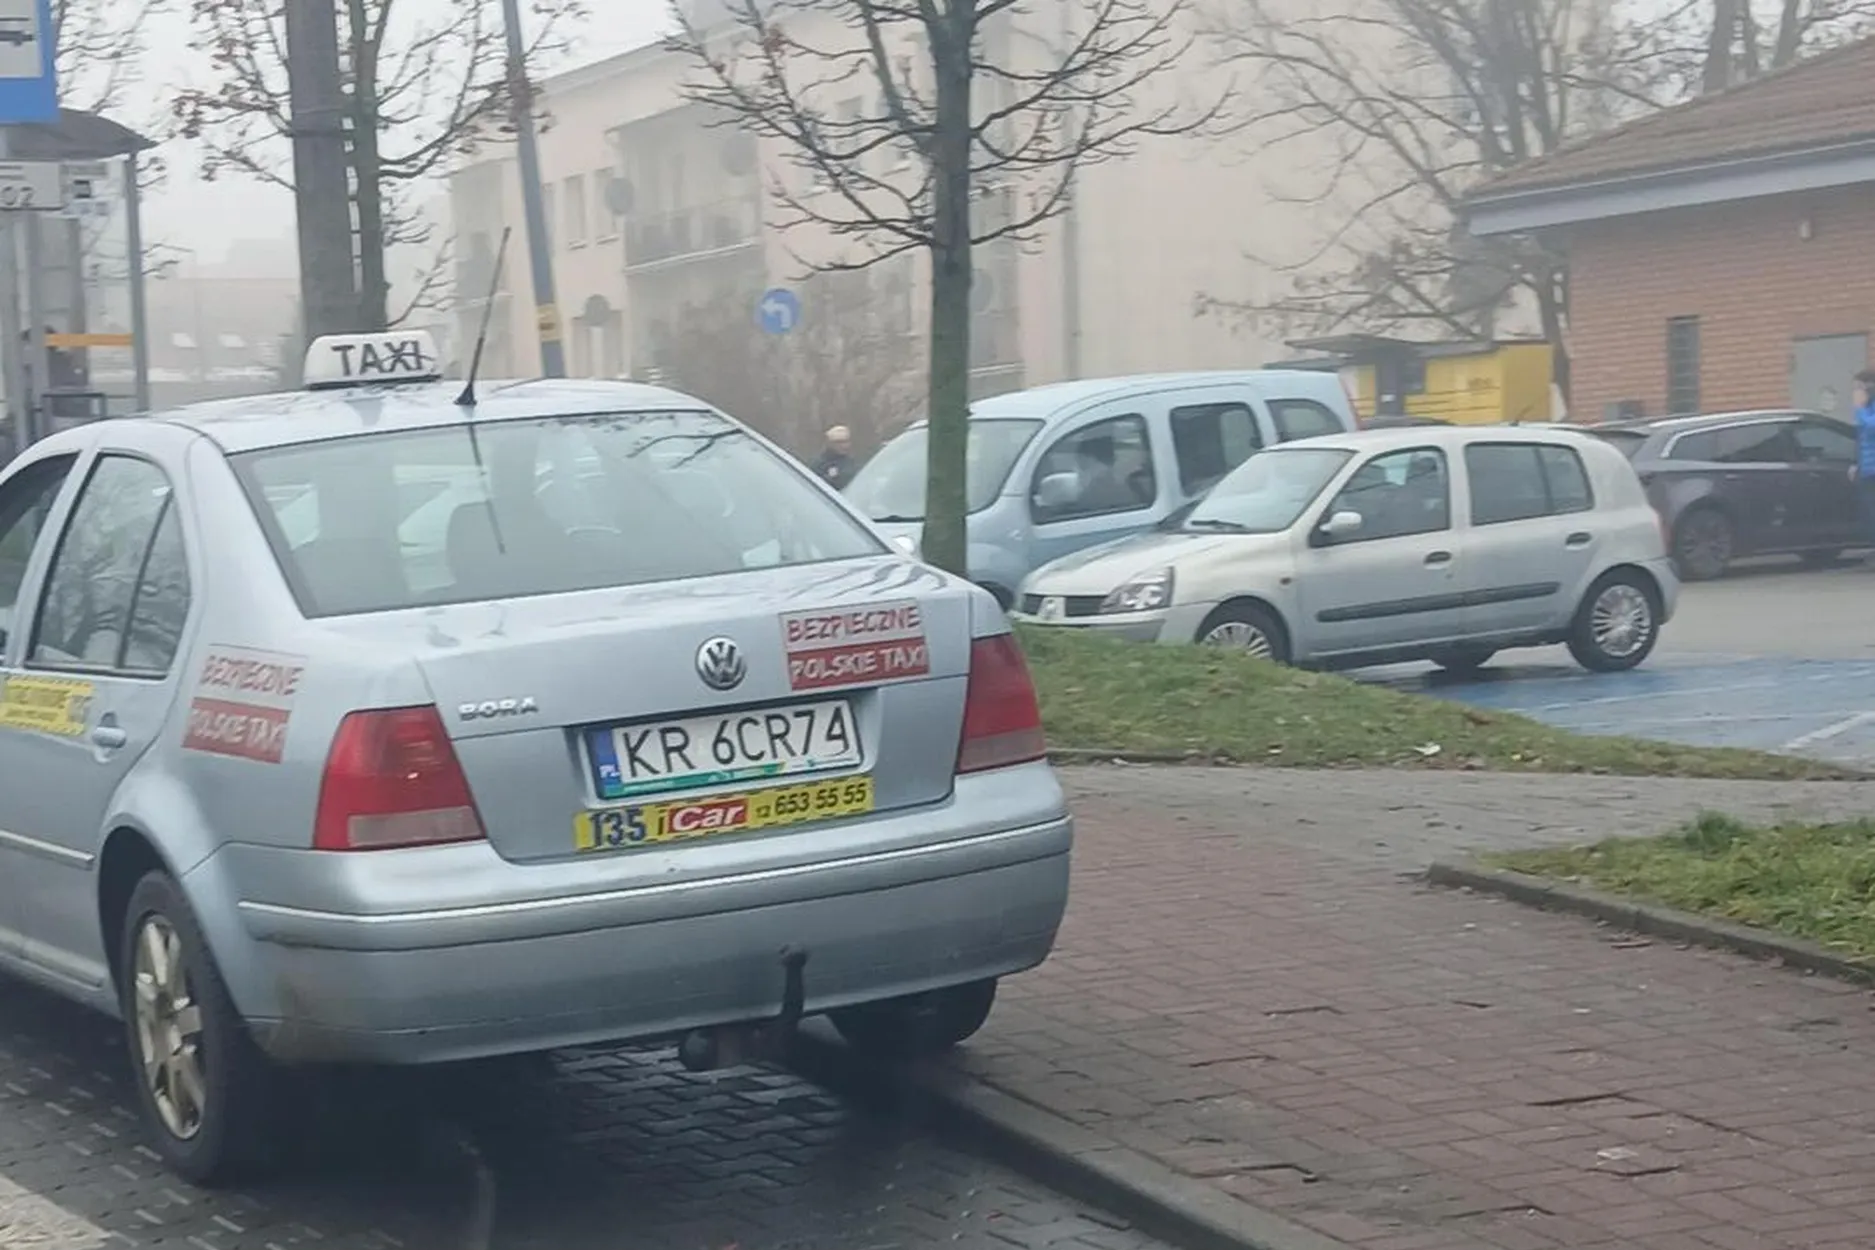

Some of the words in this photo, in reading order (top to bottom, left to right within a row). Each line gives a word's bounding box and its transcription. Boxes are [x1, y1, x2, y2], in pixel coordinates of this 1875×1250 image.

[331, 340, 423, 376] TAXI
[787, 606, 921, 642] BEZPIECZNE
[790, 651, 878, 682] POLSKIE
[879, 643, 926, 672] TAXI
[459, 697, 538, 721] BORA
[623, 716, 696, 777] KR
[711, 707, 850, 764] 6CR74
[656, 803, 744, 836] iCar
[774, 795, 811, 814] 653
[815, 788, 842, 808] 55
[844, 783, 867, 803] 55
